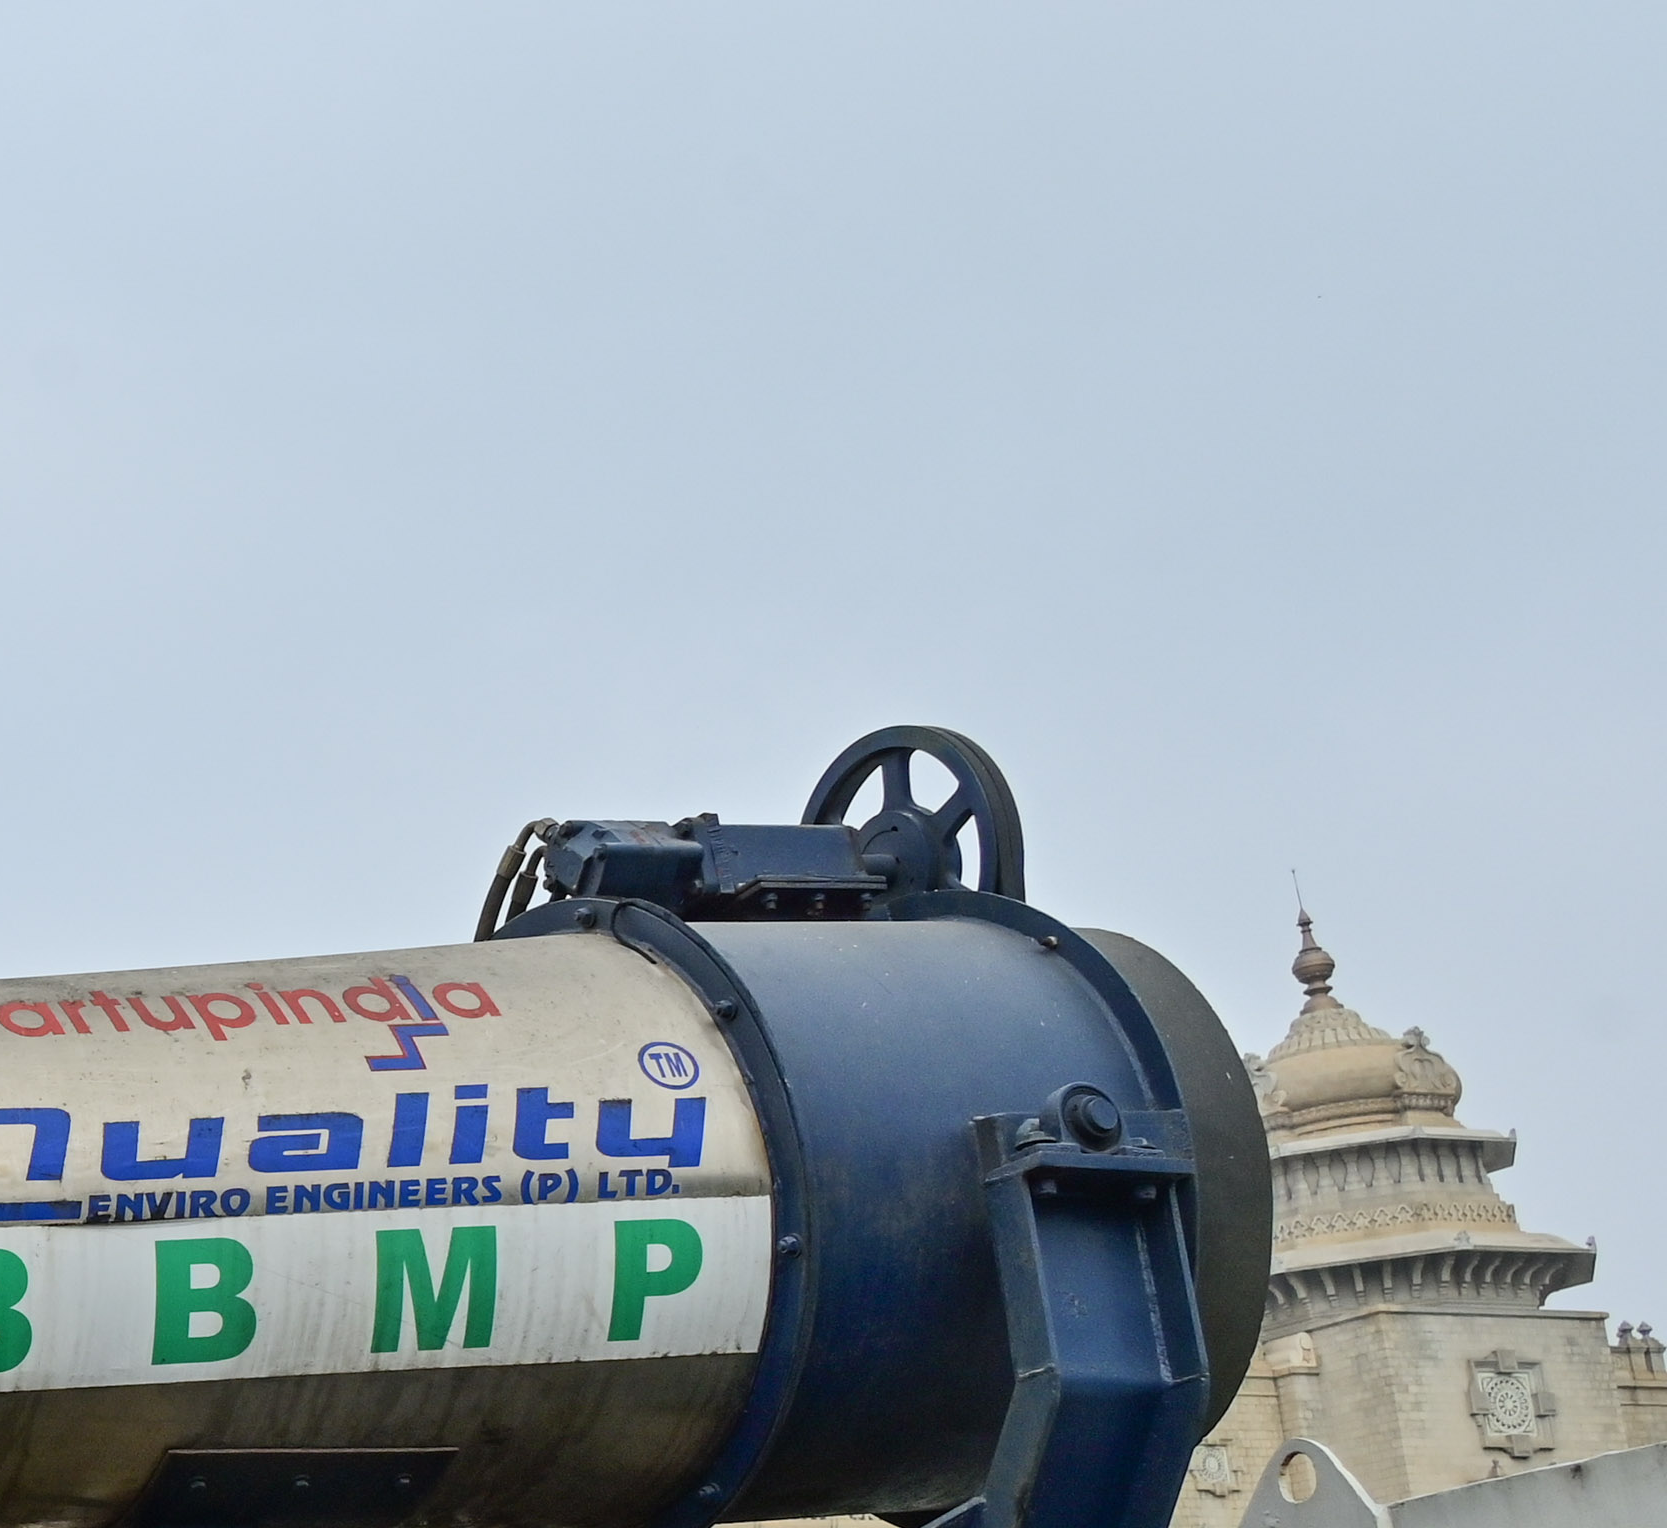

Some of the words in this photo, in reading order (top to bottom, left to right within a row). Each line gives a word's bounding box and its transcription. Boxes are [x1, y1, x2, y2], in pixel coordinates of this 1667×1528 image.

[87, 1187, 251, 1224] ENVIRO
[266, 1175, 503, 1215] ENGINEERS
[520, 1168, 579, 1205] (P)
[597, 1168, 680, 1199] LTD.
